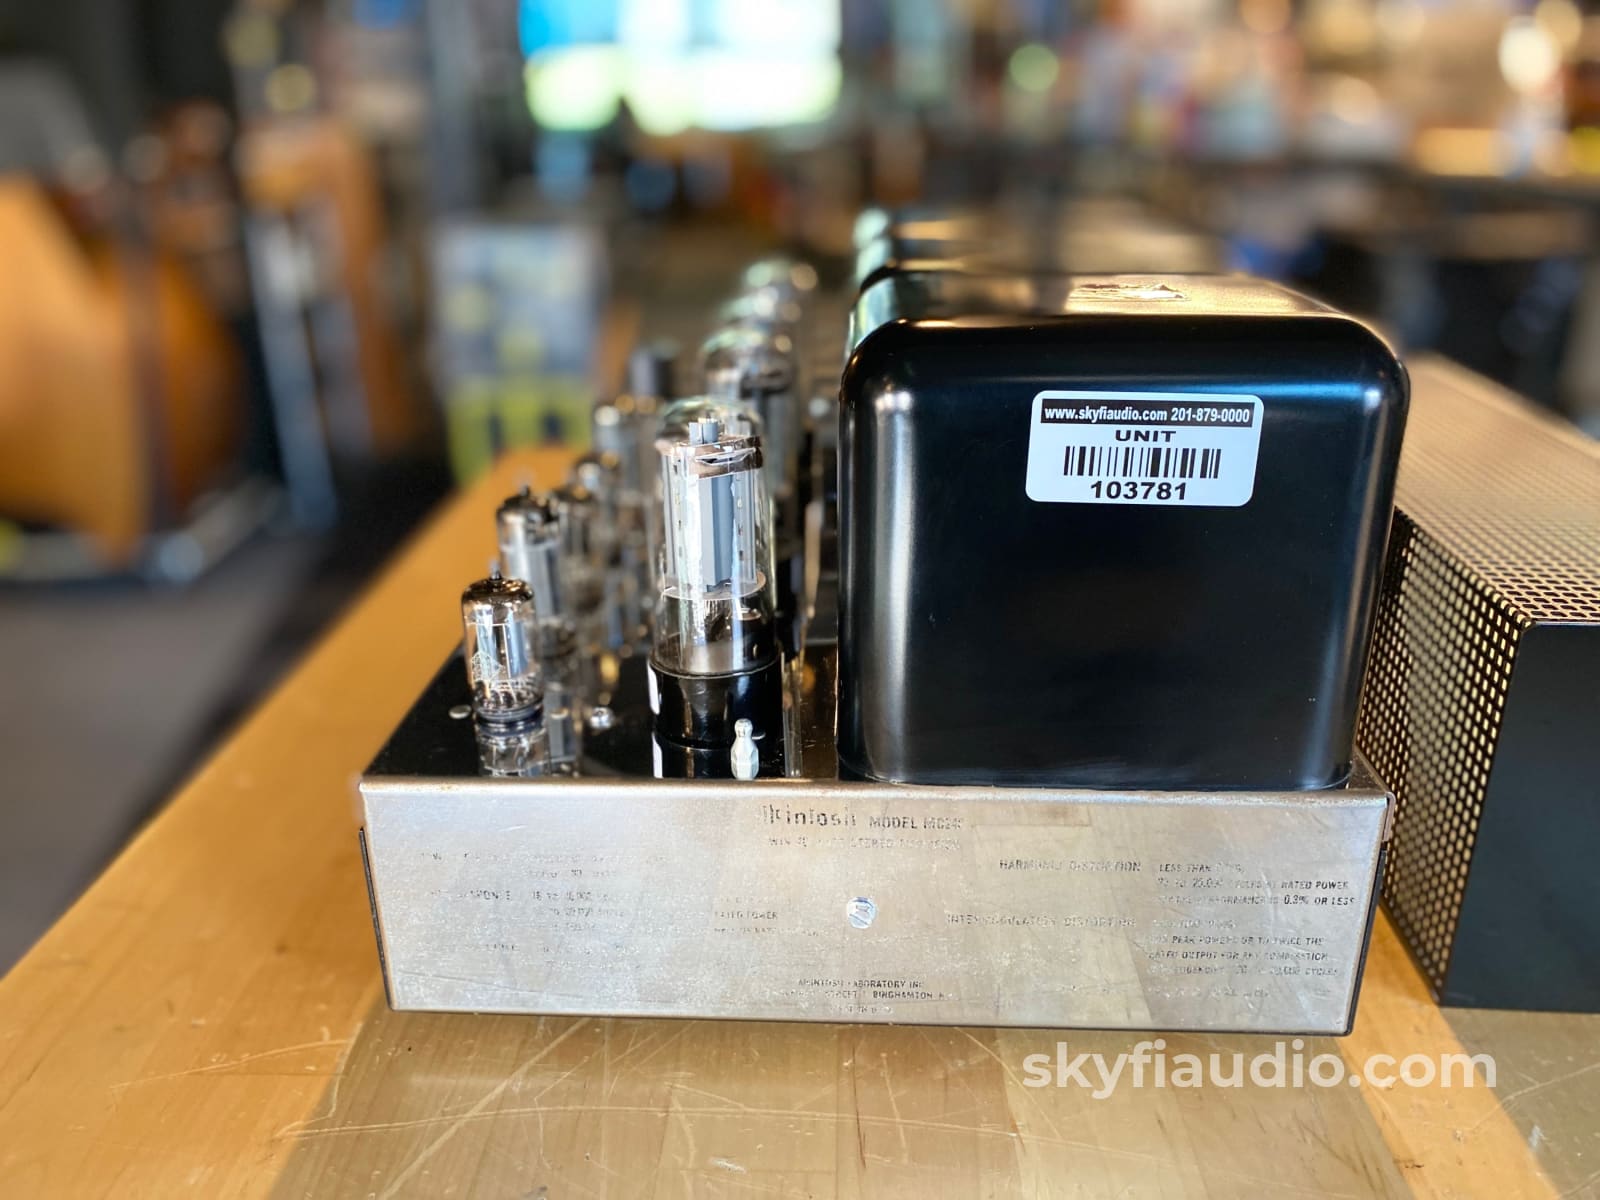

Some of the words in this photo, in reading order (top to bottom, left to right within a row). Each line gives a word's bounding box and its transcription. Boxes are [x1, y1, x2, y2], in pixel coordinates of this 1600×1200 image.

[1044, 405, 1168, 423] www.skyfiaudio.com
[1170, 407, 1250, 423] 201-879-0000
[1115, 430, 1176, 442] UNIT
[1090, 481, 1187, 500] 103781
[869, 816, 918, 830] MODEL
[1314, 896, 1328, 906] OR
[847, 979, 906, 989] ABORATORY
